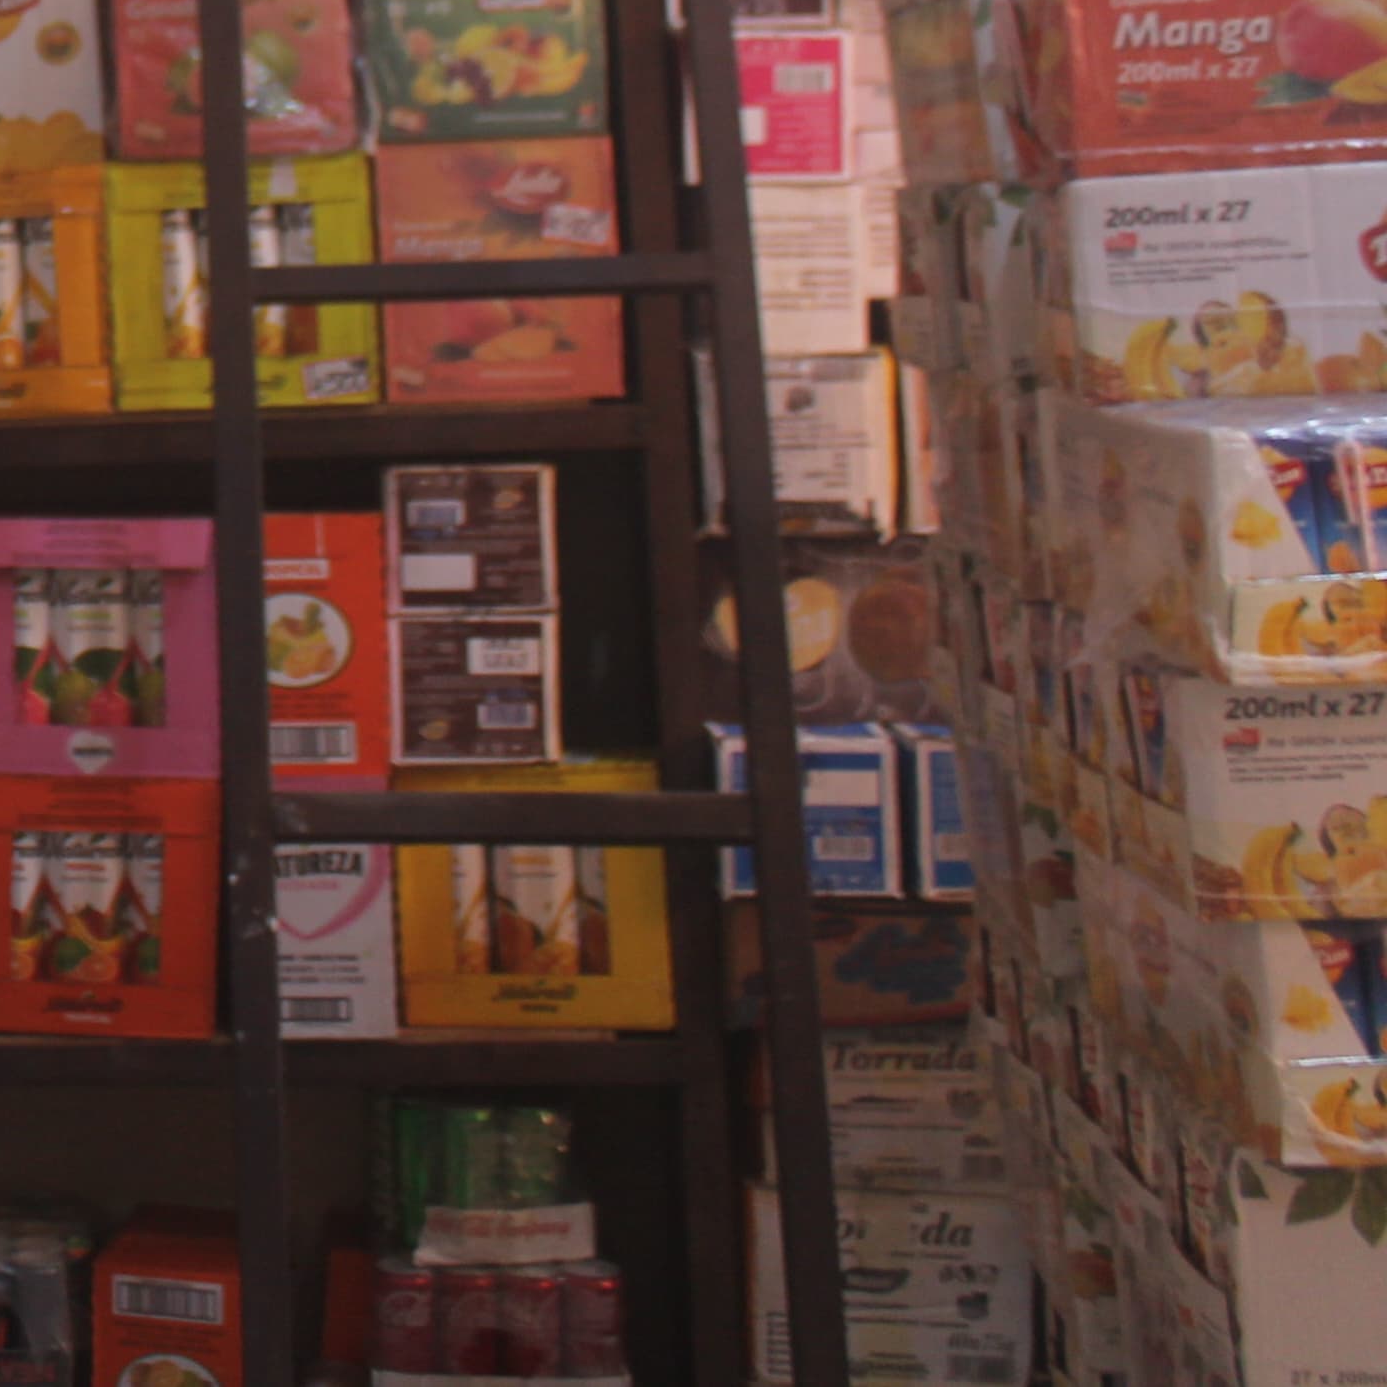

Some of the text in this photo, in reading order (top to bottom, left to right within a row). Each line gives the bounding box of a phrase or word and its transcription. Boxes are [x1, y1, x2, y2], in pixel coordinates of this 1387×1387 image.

[1113, 10, 1272, 53] Manga
[1117, 60, 1204, 85] 200ml
[1229, 56, 1259, 78] 27
[1195, 209, 1212, 223] x
[1218, 199, 1251, 221] 27
[1329, 698, 1344, 715] x
[1347, 692, 1385, 717] 27
[829, 1043, 977, 1073] Torrada
